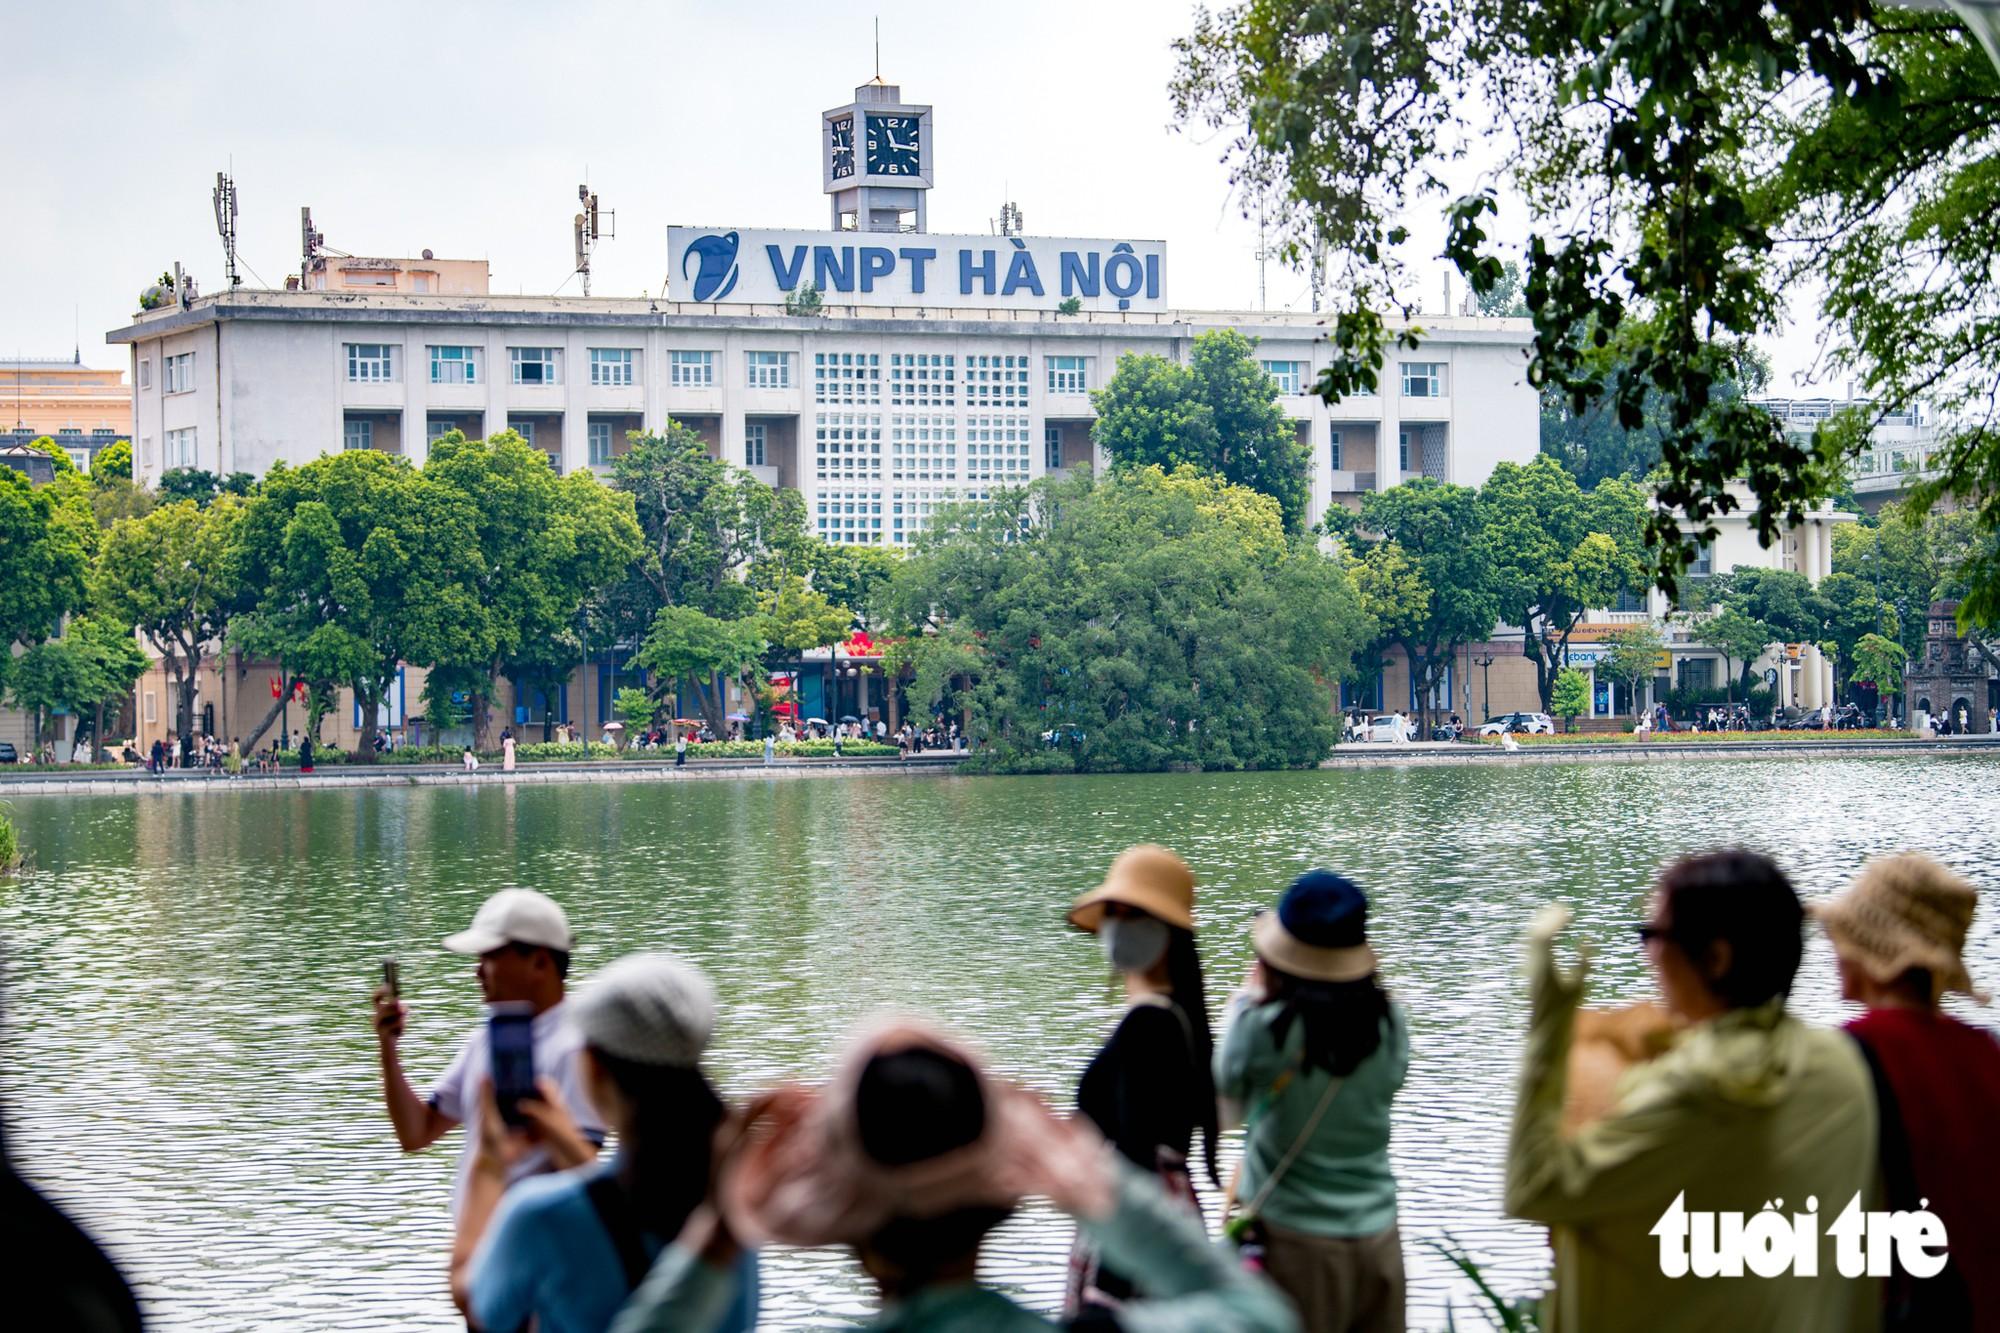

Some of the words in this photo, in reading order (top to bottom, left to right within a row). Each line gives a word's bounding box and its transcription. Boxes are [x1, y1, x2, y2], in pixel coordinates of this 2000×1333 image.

[887, 118, 899, 128] 12
[868, 140, 877, 150] 9
[889, 164, 898, 173] 6
[766, 244, 937, 294] VNPT
[959, 238, 1045, 297] HÀ
[1059, 243, 1160, 310] NỘI
